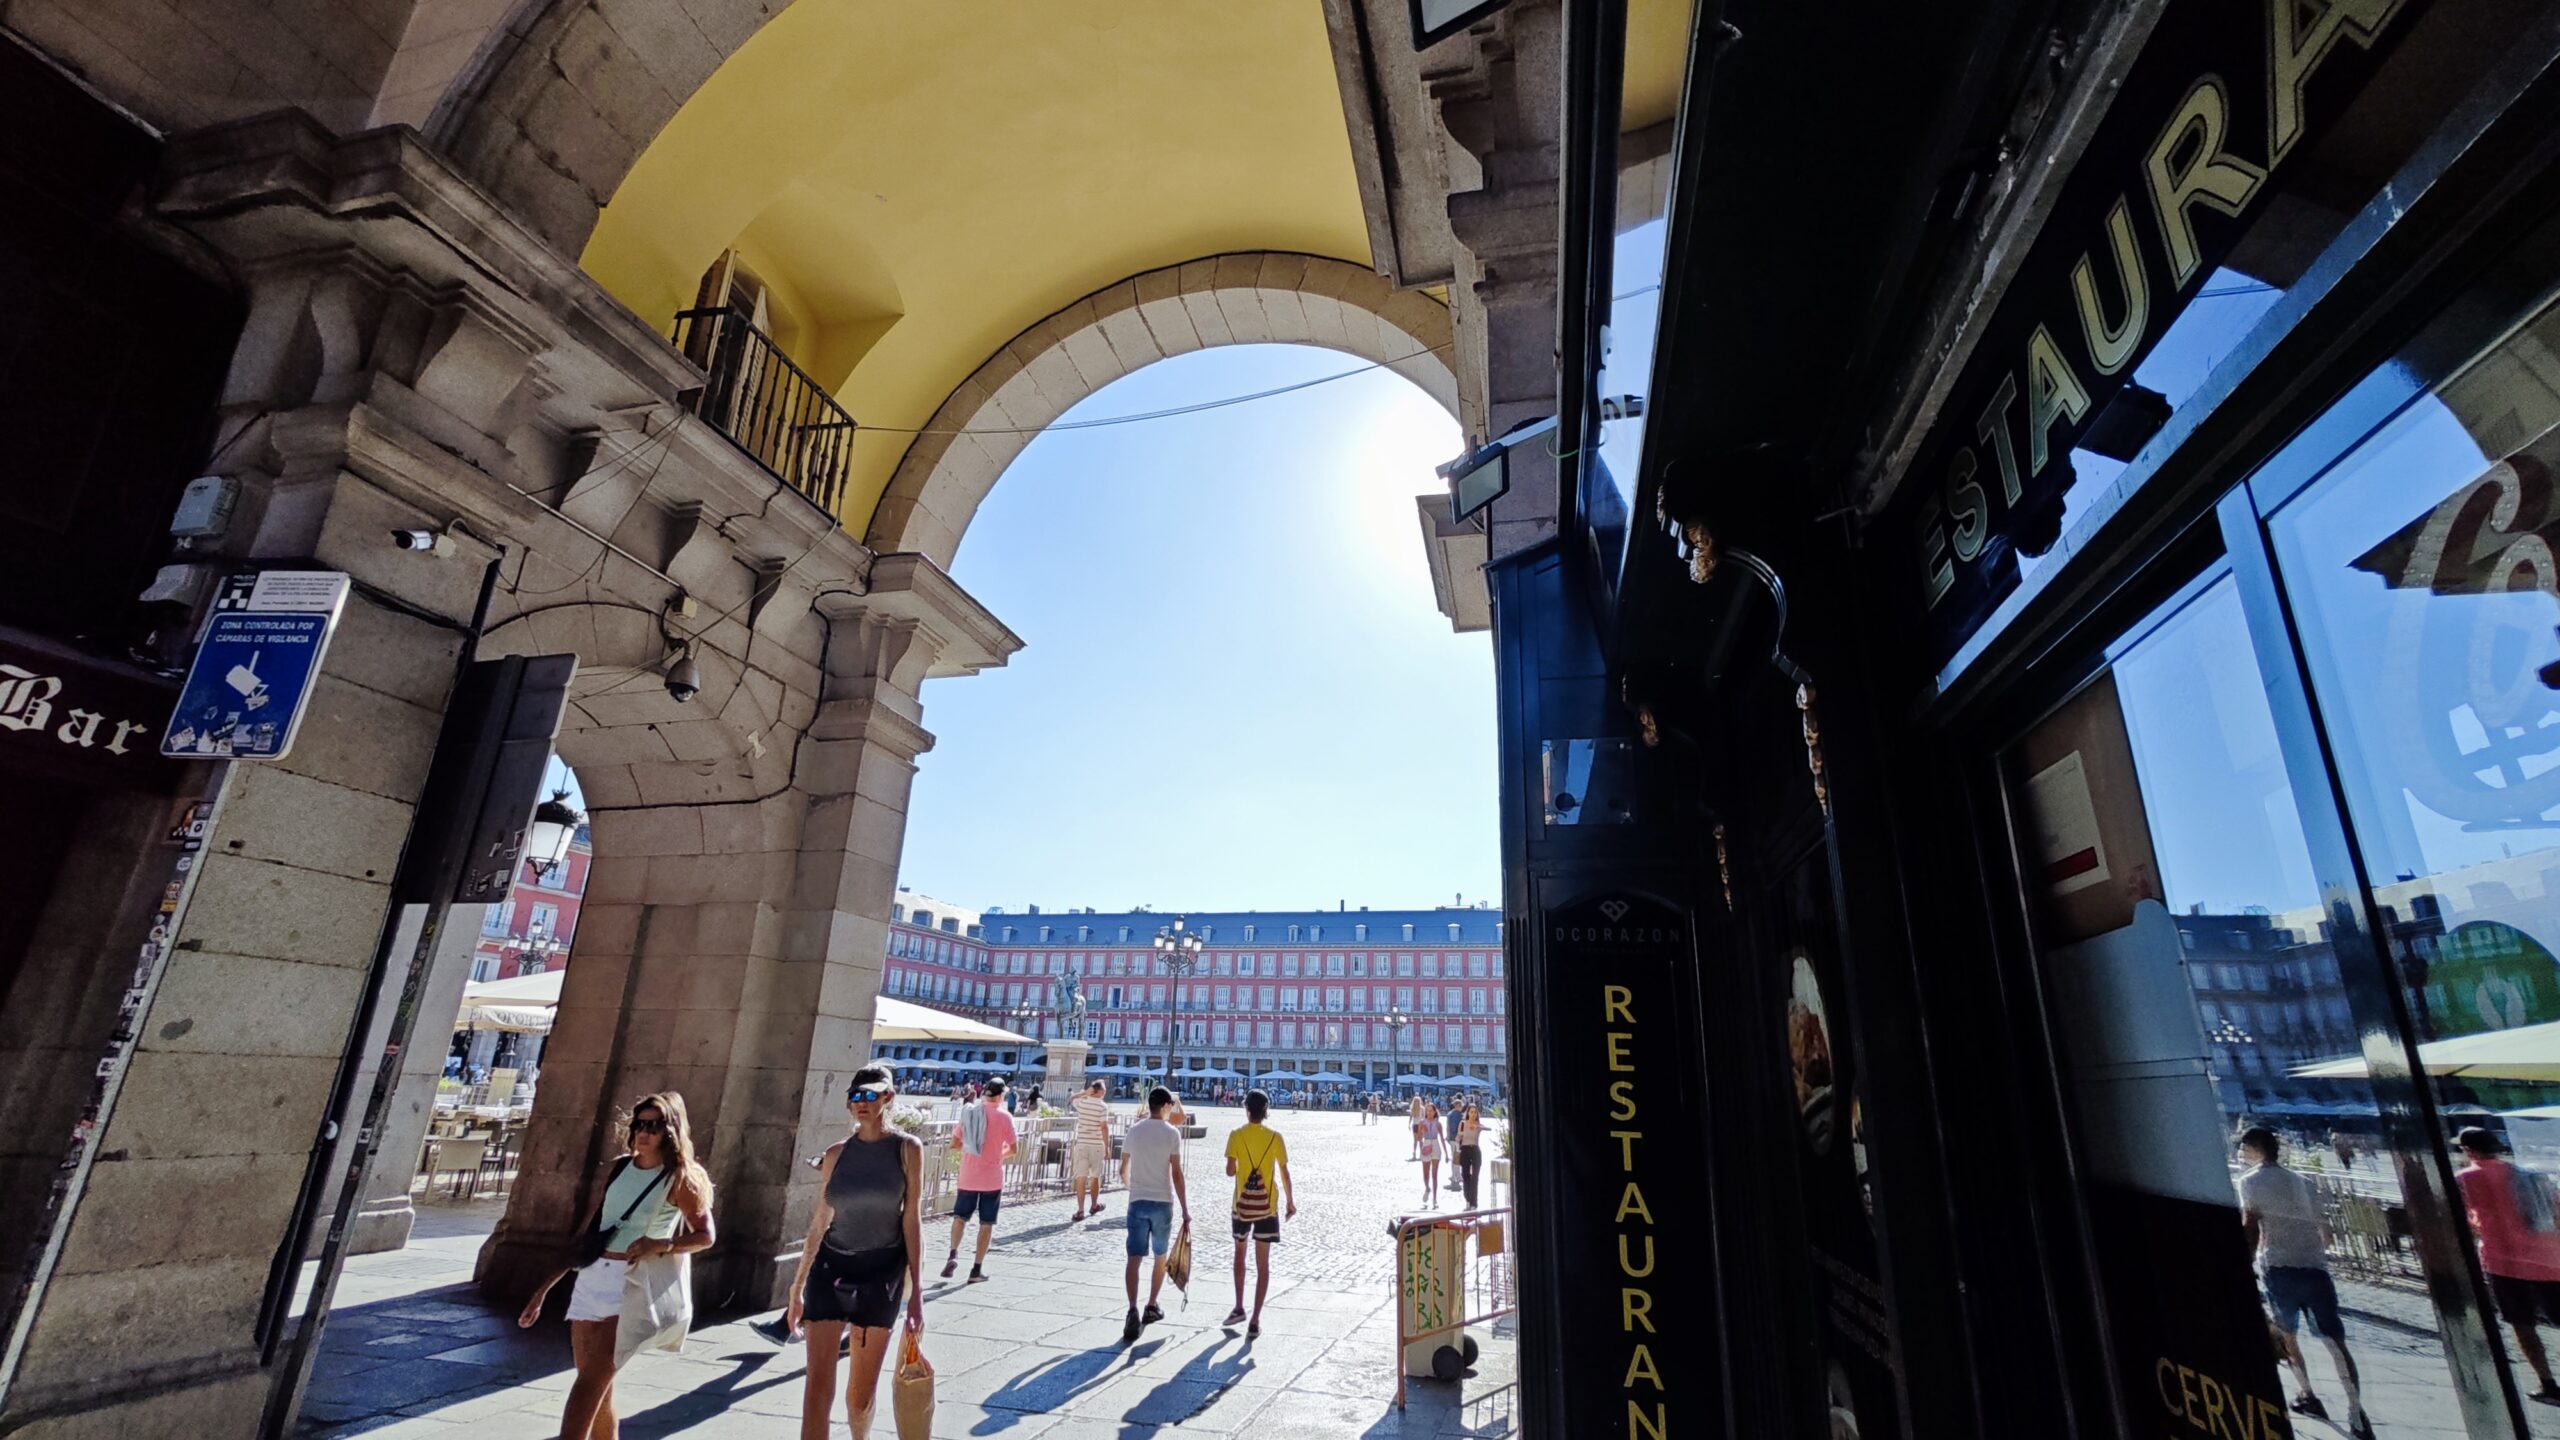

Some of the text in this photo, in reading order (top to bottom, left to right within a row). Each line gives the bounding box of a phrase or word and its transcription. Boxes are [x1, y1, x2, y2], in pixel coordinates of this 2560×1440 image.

[221, 621, 315, 630] ZONA CONTROLADA POR
[254, 635, 265, 643] DE
[267, 635, 309, 643] VIGILANCIA
[0, 663, 148, 756] Bar
[1604, 984, 1667, 1440] RESTAURAN
